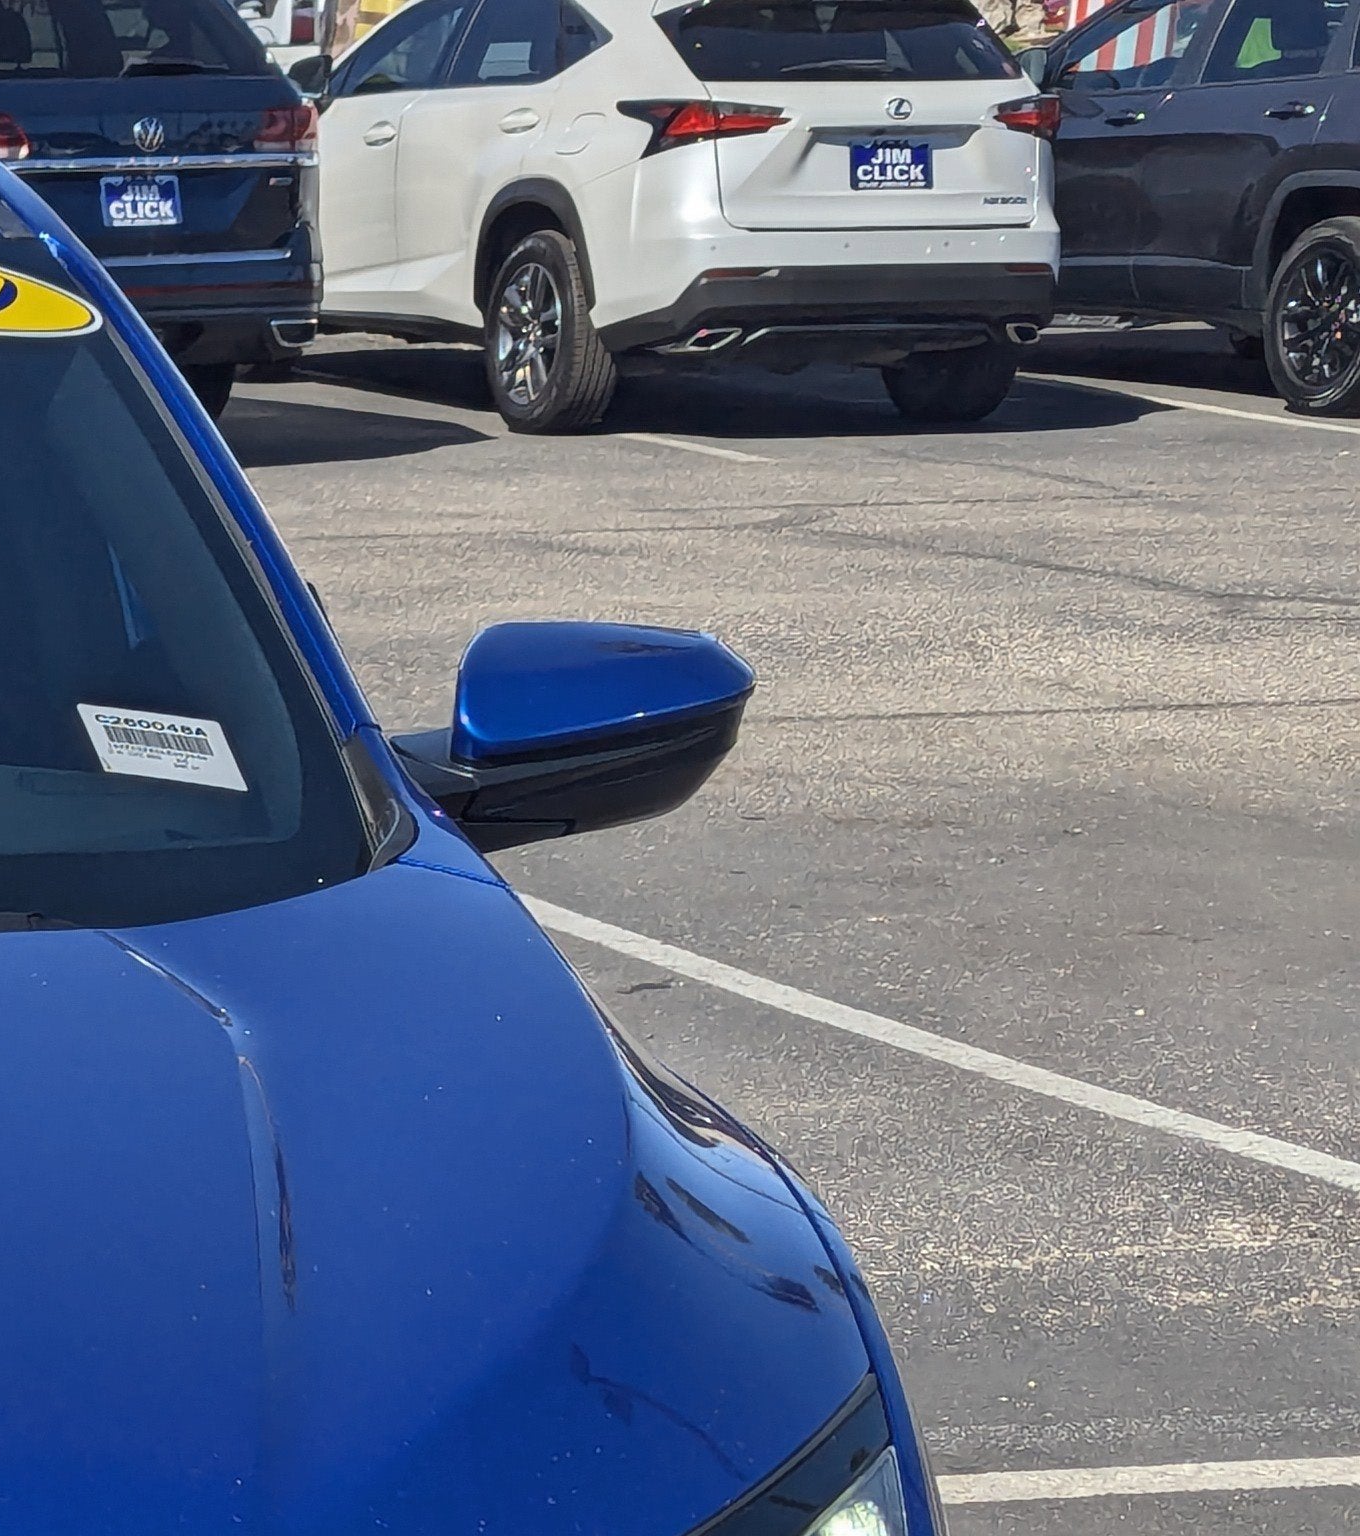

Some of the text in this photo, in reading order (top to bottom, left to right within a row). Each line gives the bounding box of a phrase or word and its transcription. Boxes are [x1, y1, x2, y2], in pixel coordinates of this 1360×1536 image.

[870, 148, 912, 164] JIM
[856, 164, 925, 181] CLICK
[121, 184, 161, 201] JIM
[109, 199, 174, 219] CLICK
